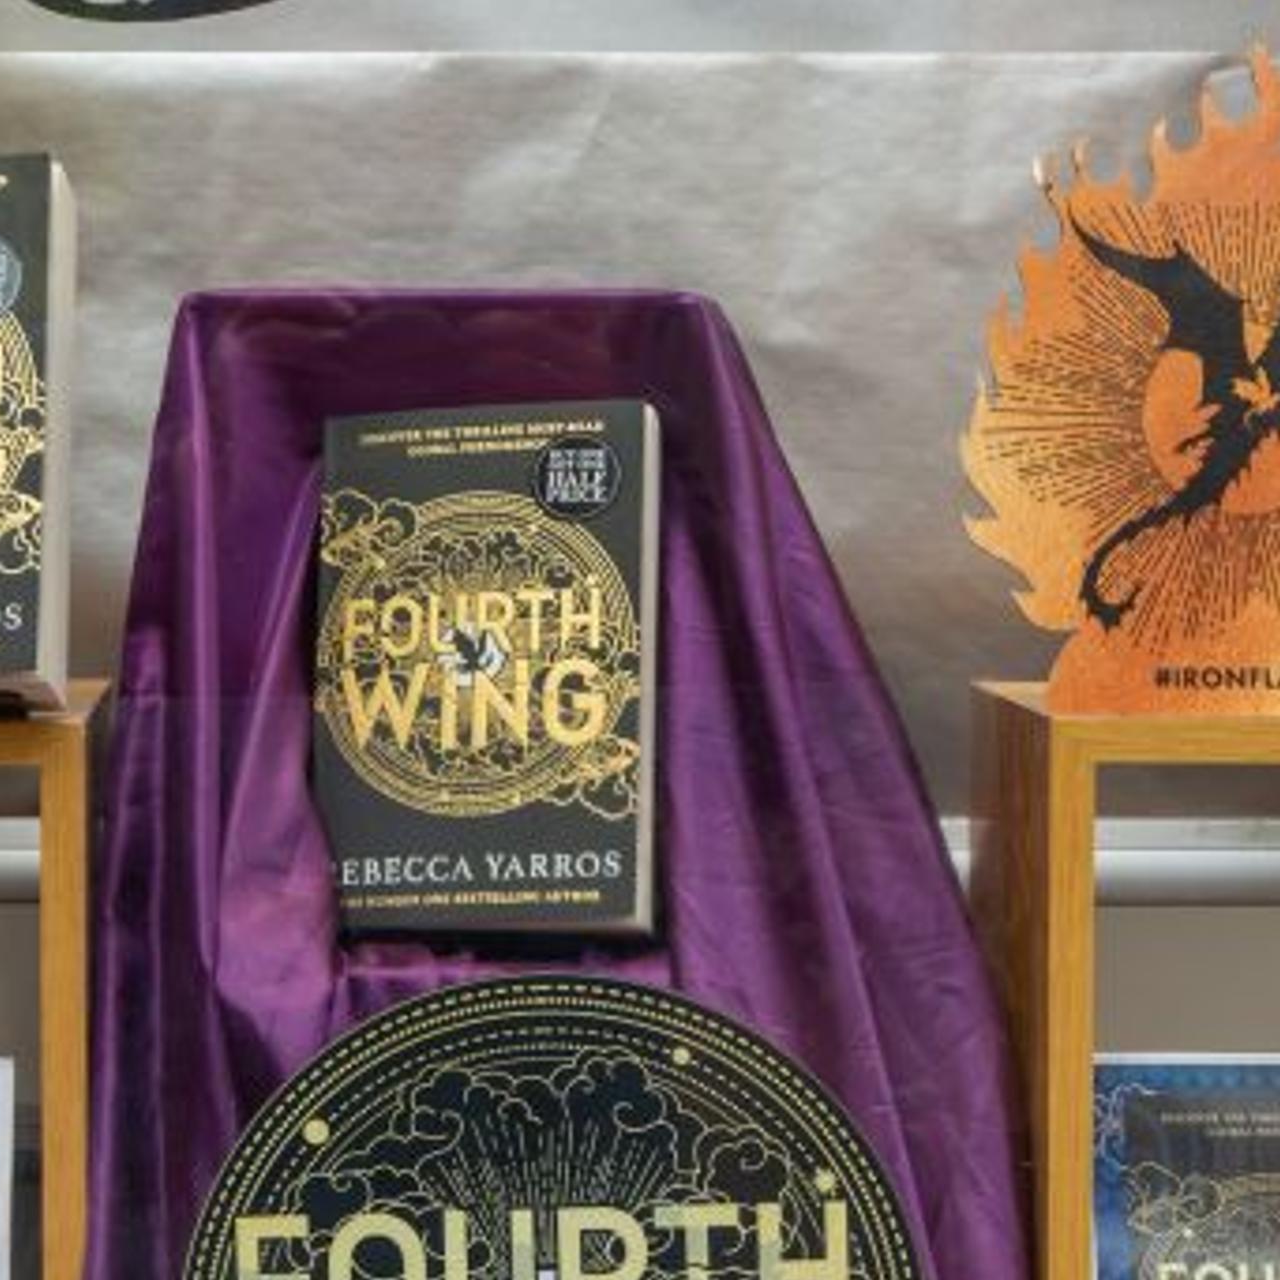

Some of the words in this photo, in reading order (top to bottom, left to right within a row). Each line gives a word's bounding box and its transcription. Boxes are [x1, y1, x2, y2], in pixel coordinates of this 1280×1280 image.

[548, 470, 608, 488] HALF
[342, 586, 603, 661] FOURTH
[341, 657, 609, 753] WING
[338, 853, 474, 887] EBECCA
[484, 849, 623, 881] YARROS
